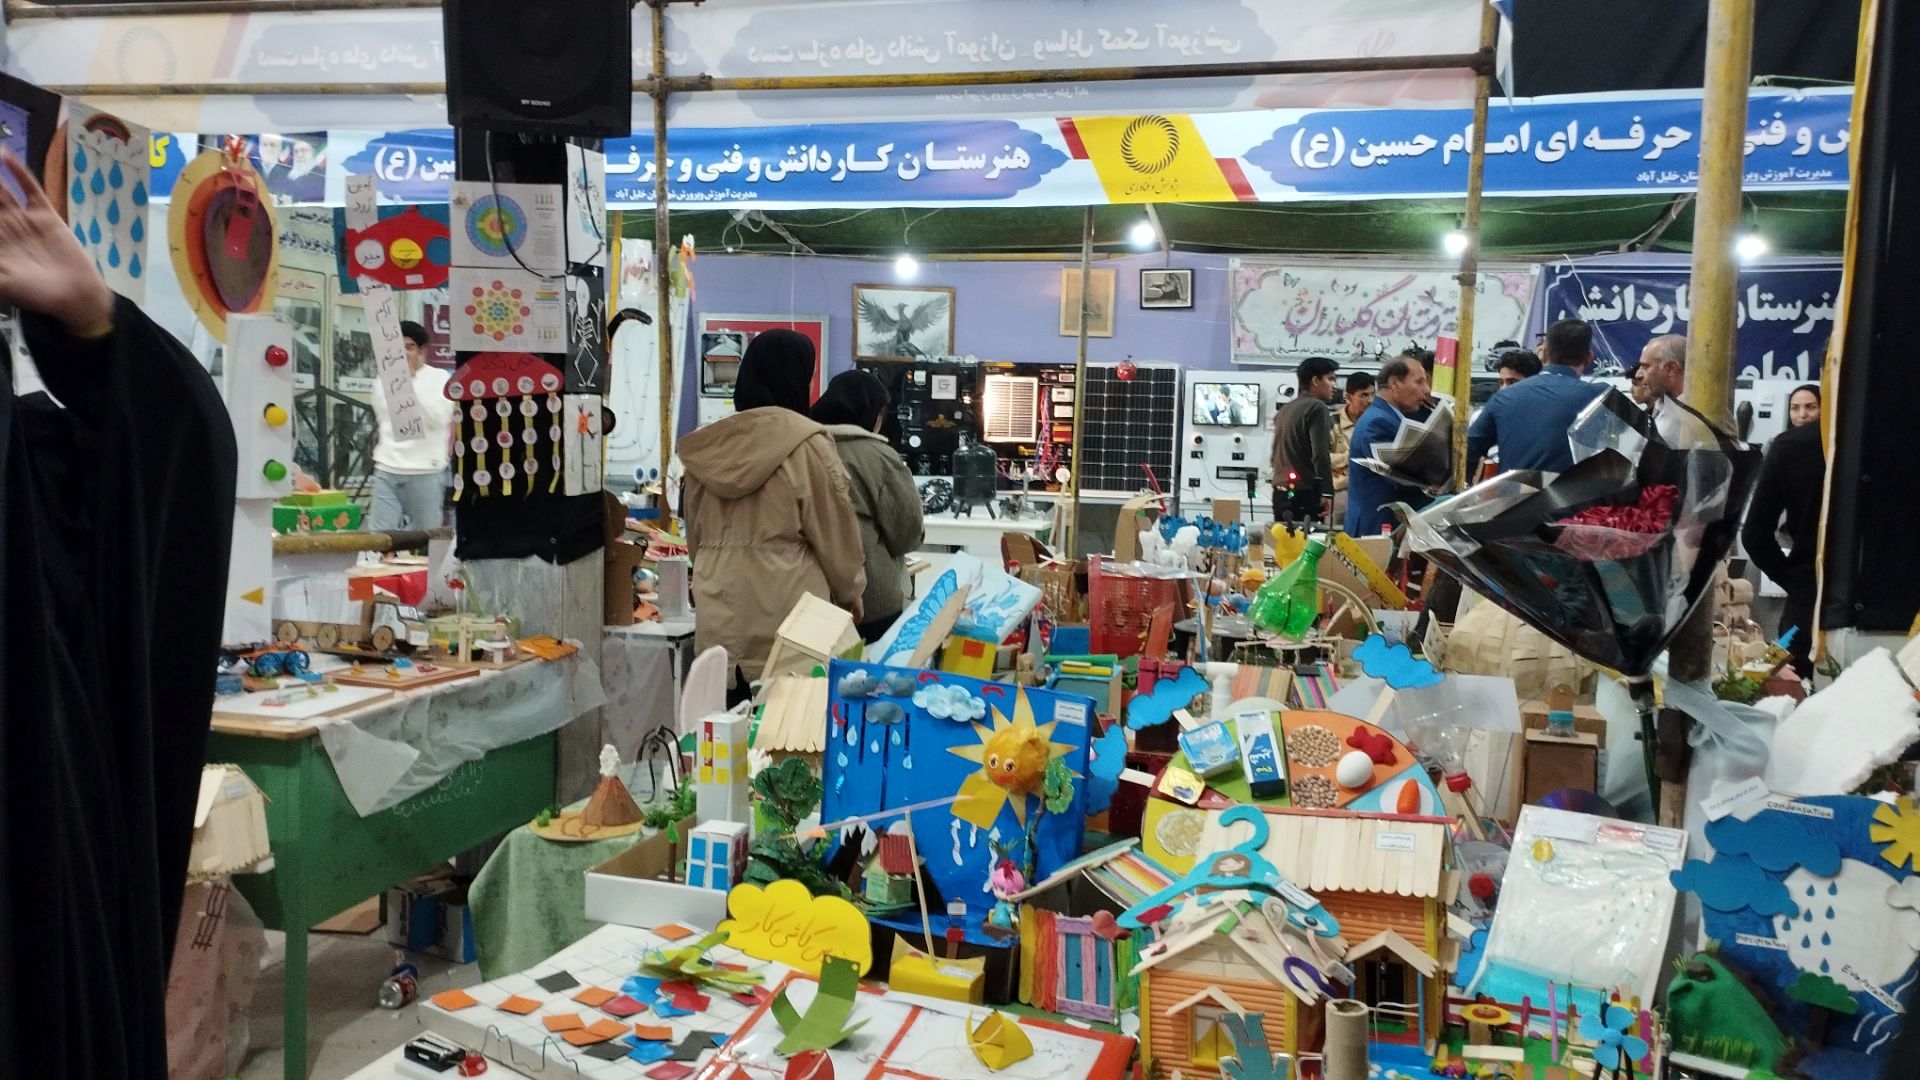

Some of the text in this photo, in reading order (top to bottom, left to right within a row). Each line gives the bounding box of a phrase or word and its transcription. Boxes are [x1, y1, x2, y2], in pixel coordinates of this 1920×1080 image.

[1290, 126, 1346, 169] (ع)
[1350, 133, 1438, 168] حسین
[1534, 119, 1578, 163] ای
[1582, 115, 1693, 160] حرفه
[419, 156, 456, 182] سین
[676, 157, 693, 183] و
[695, 143, 744, 183] فنی
[745, 156, 762, 183] و
[897, 141, 1031, 181] هنرستان
[1558, 283, 1837, 334] نرستا اردانش
